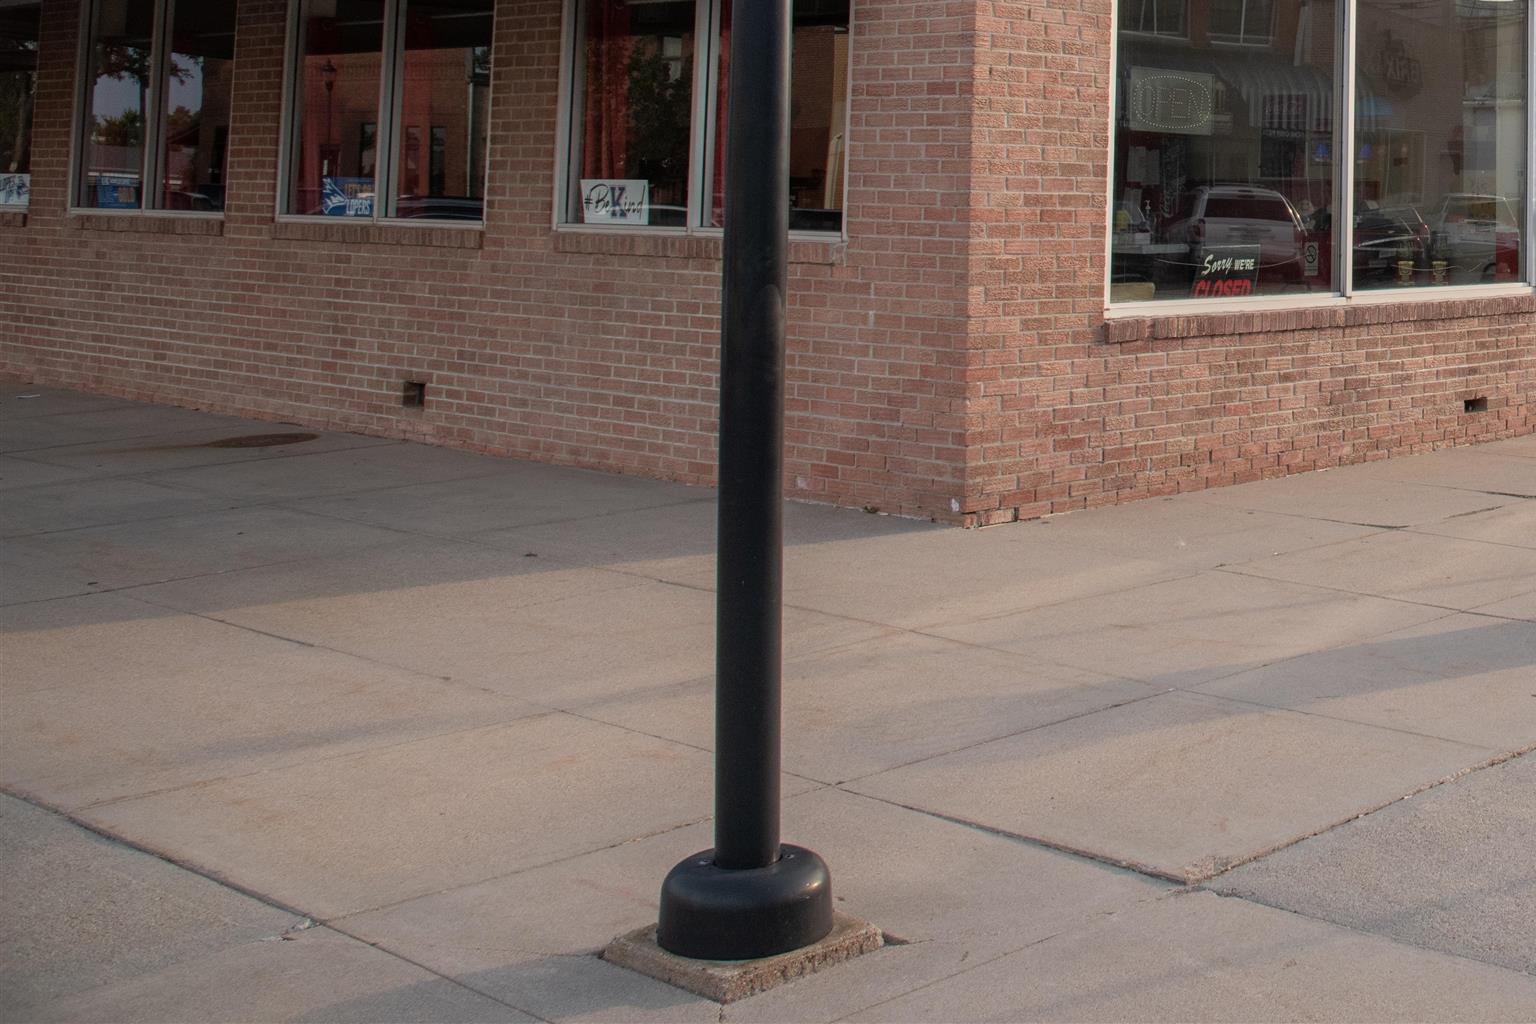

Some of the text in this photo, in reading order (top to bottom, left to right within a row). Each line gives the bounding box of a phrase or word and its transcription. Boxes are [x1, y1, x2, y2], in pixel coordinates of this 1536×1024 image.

[1139, 85, 1204, 120] OPEN
[1201, 254, 1255, 276] Sorry WE'RE
